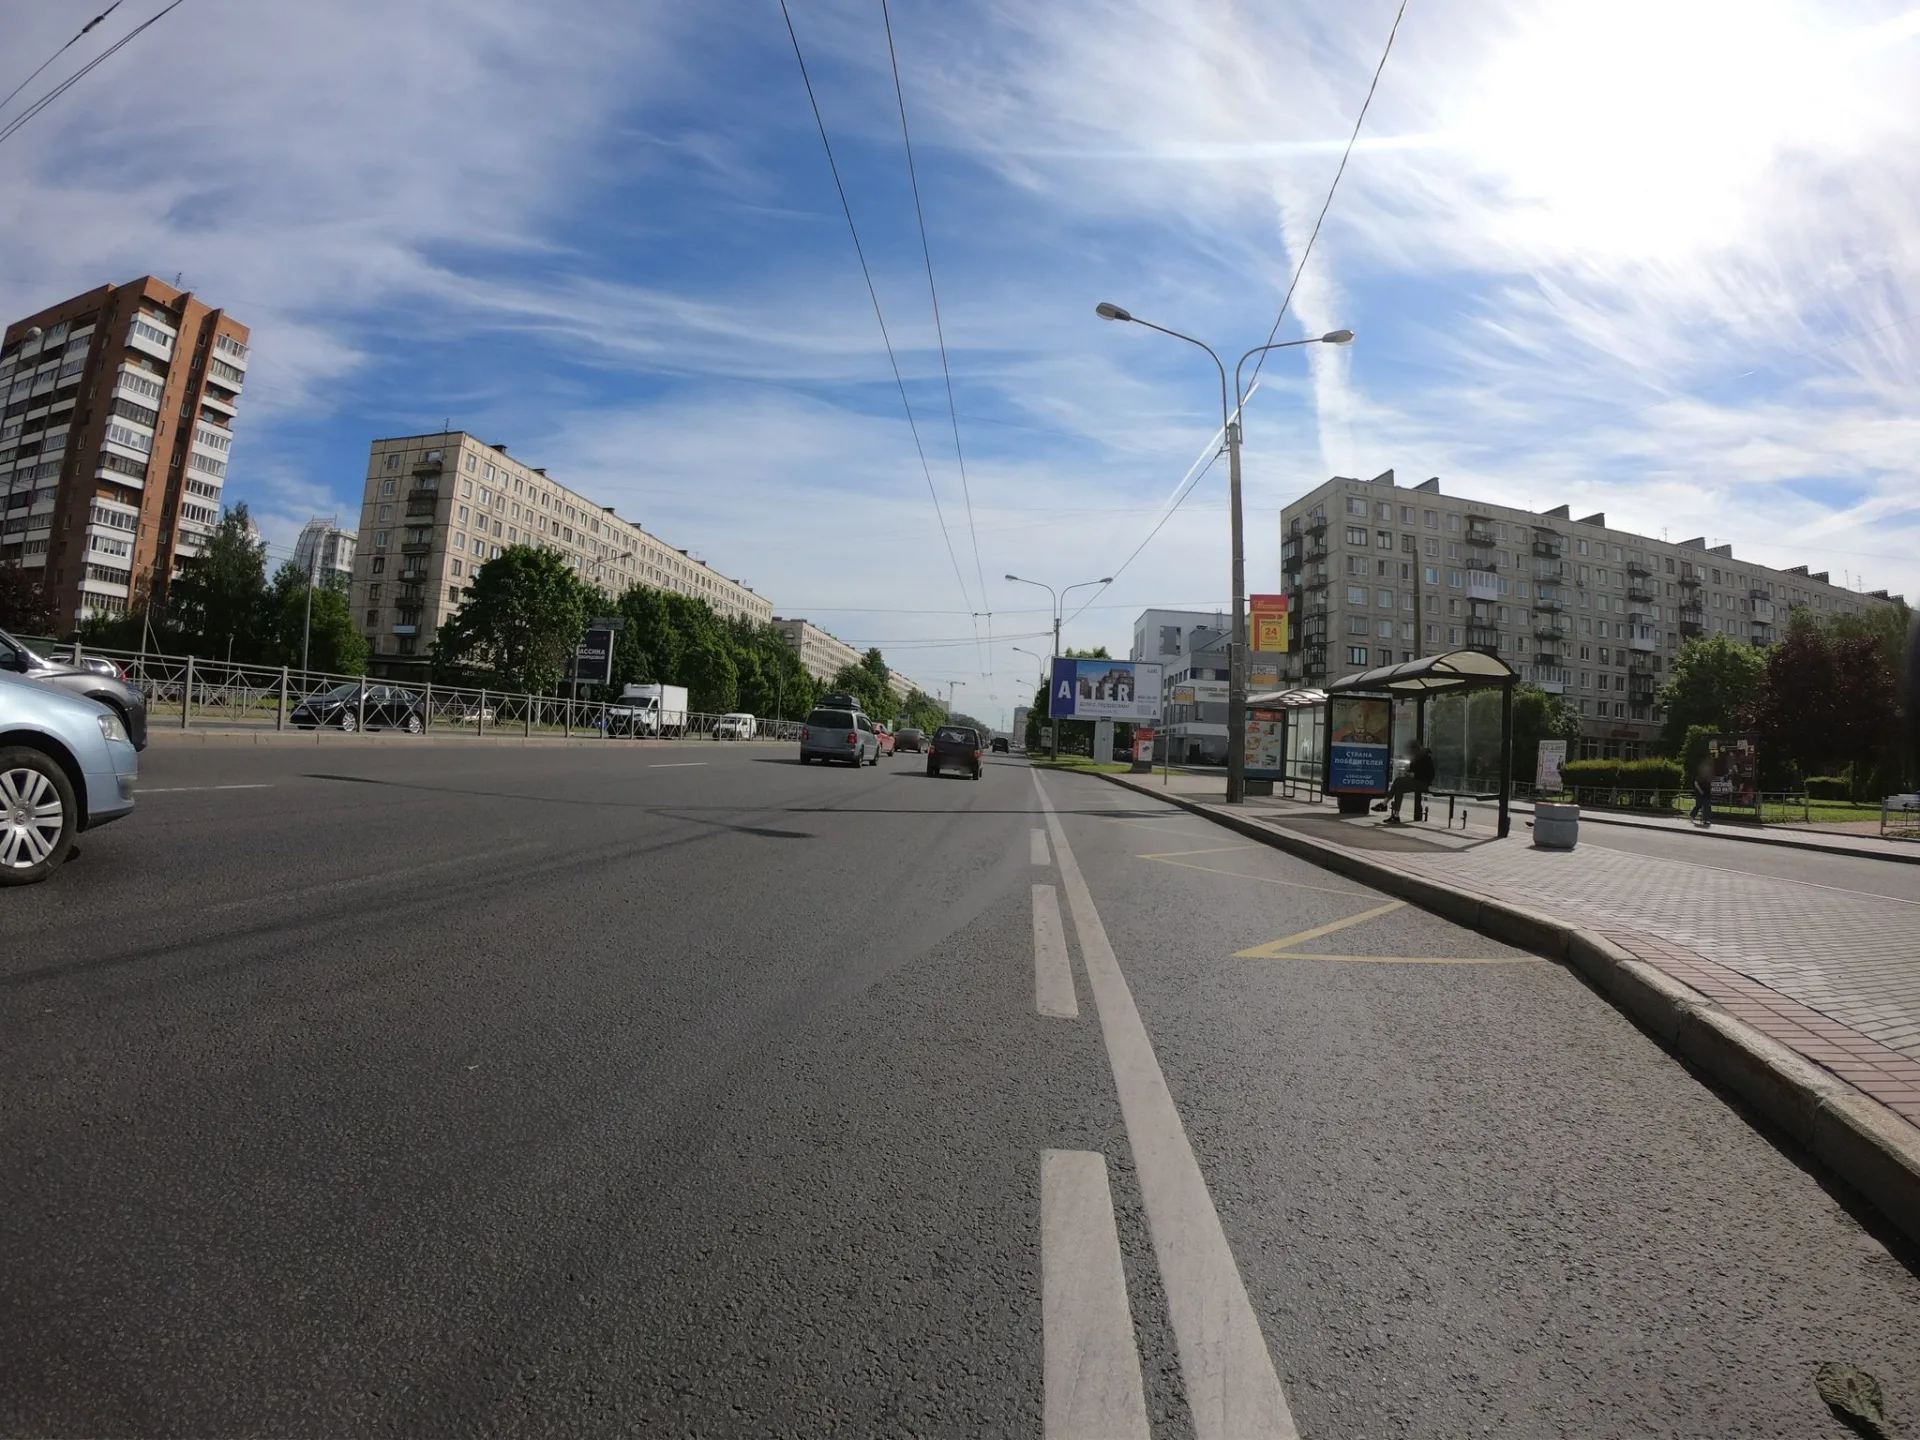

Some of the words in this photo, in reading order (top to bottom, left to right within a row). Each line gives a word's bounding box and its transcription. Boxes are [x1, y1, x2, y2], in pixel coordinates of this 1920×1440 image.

[1264, 627, 1278, 636] 24
[1058, 680, 1130, 702] ALTER
[1334, 758, 1384, 766] ПОБЕДИТЕЛЕЙ
